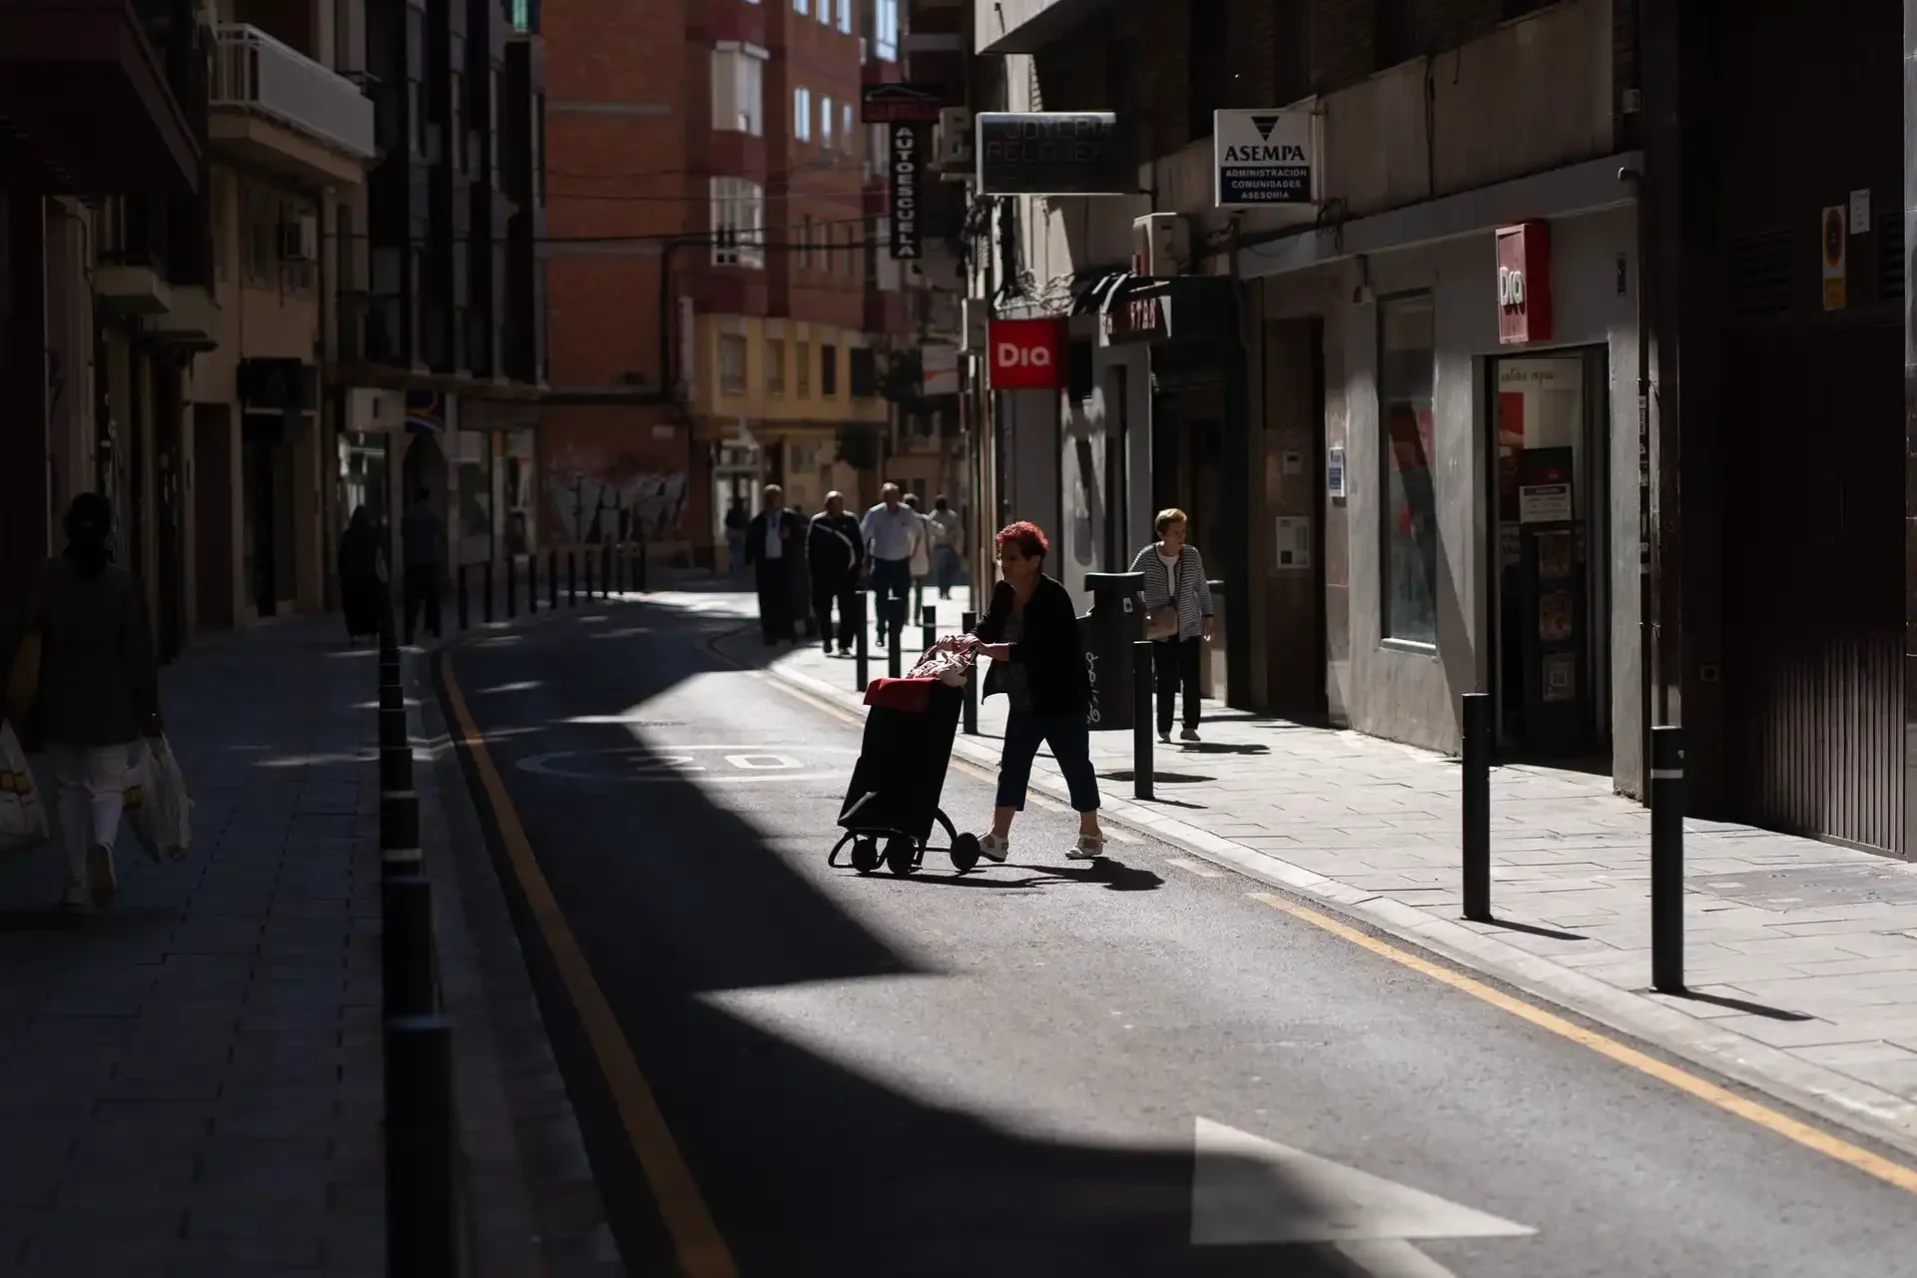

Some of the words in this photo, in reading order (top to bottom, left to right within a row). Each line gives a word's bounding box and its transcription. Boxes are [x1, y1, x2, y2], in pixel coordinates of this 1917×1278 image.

[1225, 145, 1306, 161] ASEMPA
[895, 126, 915, 257] AUTOESCUELA
[1231, 180, 1301, 189] COMUNIDADES
